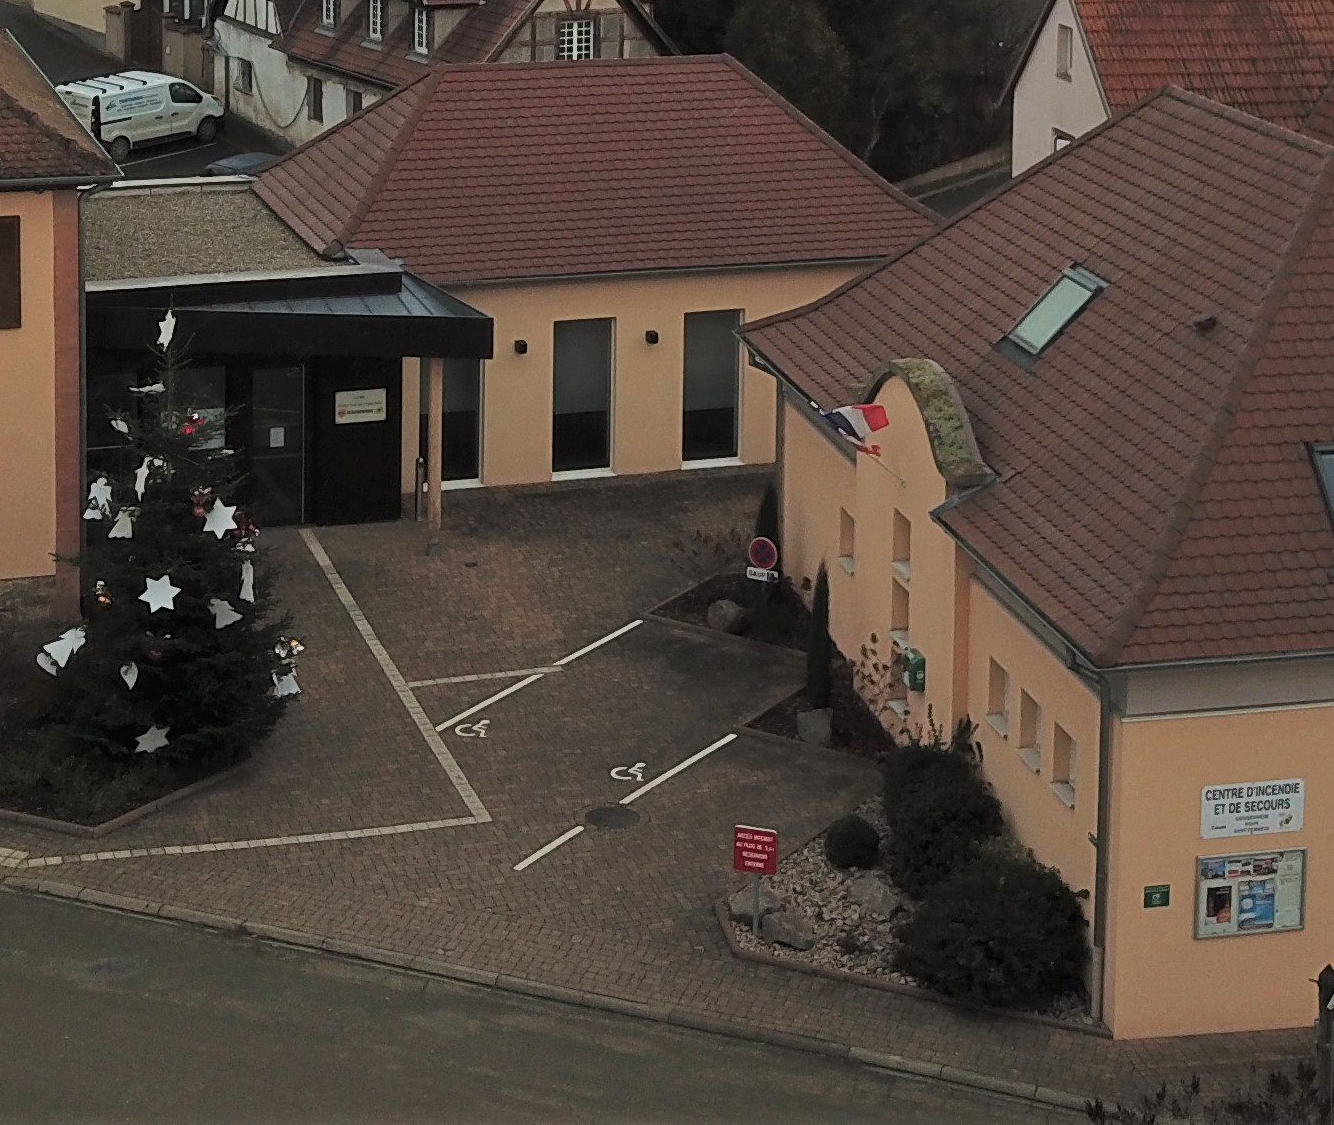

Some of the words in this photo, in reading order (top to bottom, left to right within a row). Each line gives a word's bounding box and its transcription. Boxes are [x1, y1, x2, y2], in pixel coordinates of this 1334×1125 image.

[1205, 787, 1245, 802] CENTRE
[1246, 782, 1300, 798] D'INCENDIE
[1214, 803, 1227, 816] ET
[1228, 801, 1242, 814] DE
[1244, 798, 1291, 813] SECOURS
